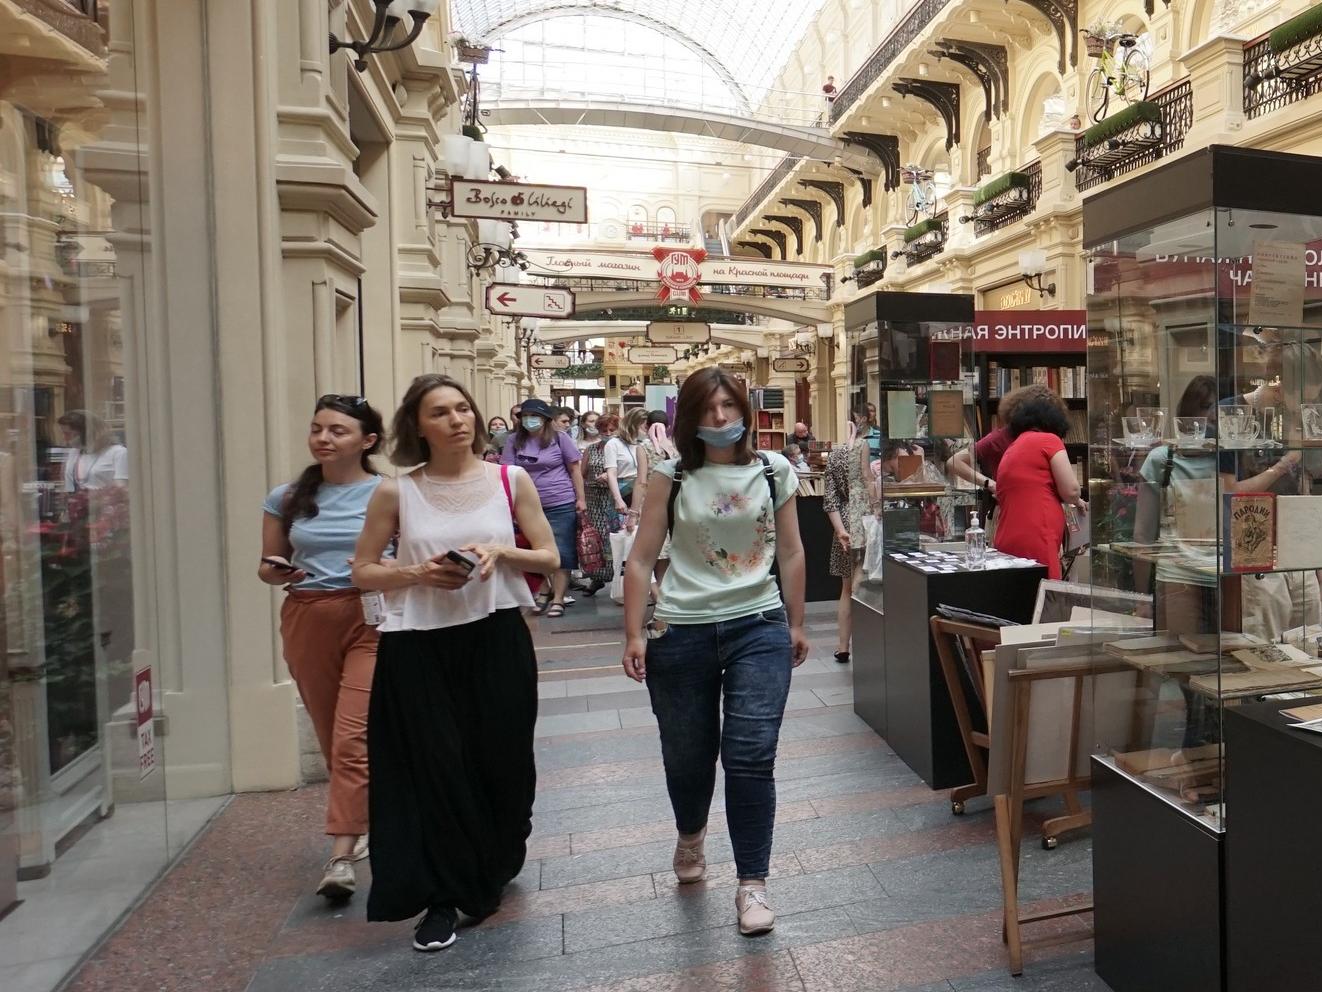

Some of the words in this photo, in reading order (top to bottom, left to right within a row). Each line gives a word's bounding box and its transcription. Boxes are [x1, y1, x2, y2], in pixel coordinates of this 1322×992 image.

[545, 256, 593, 268] Гланый
[598, 260, 641, 271] магазин
[713, 267, 726, 275] на
[728, 266, 768, 277] Красной
[770, 270, 809, 281] площади
[994, 324, 1086, 340] ЭНТРОПИ
[1233, 504, 1271, 520] ПАРОДИИ
[141, 728, 152, 750] TAX
[139, 747, 155, 770] FREE
